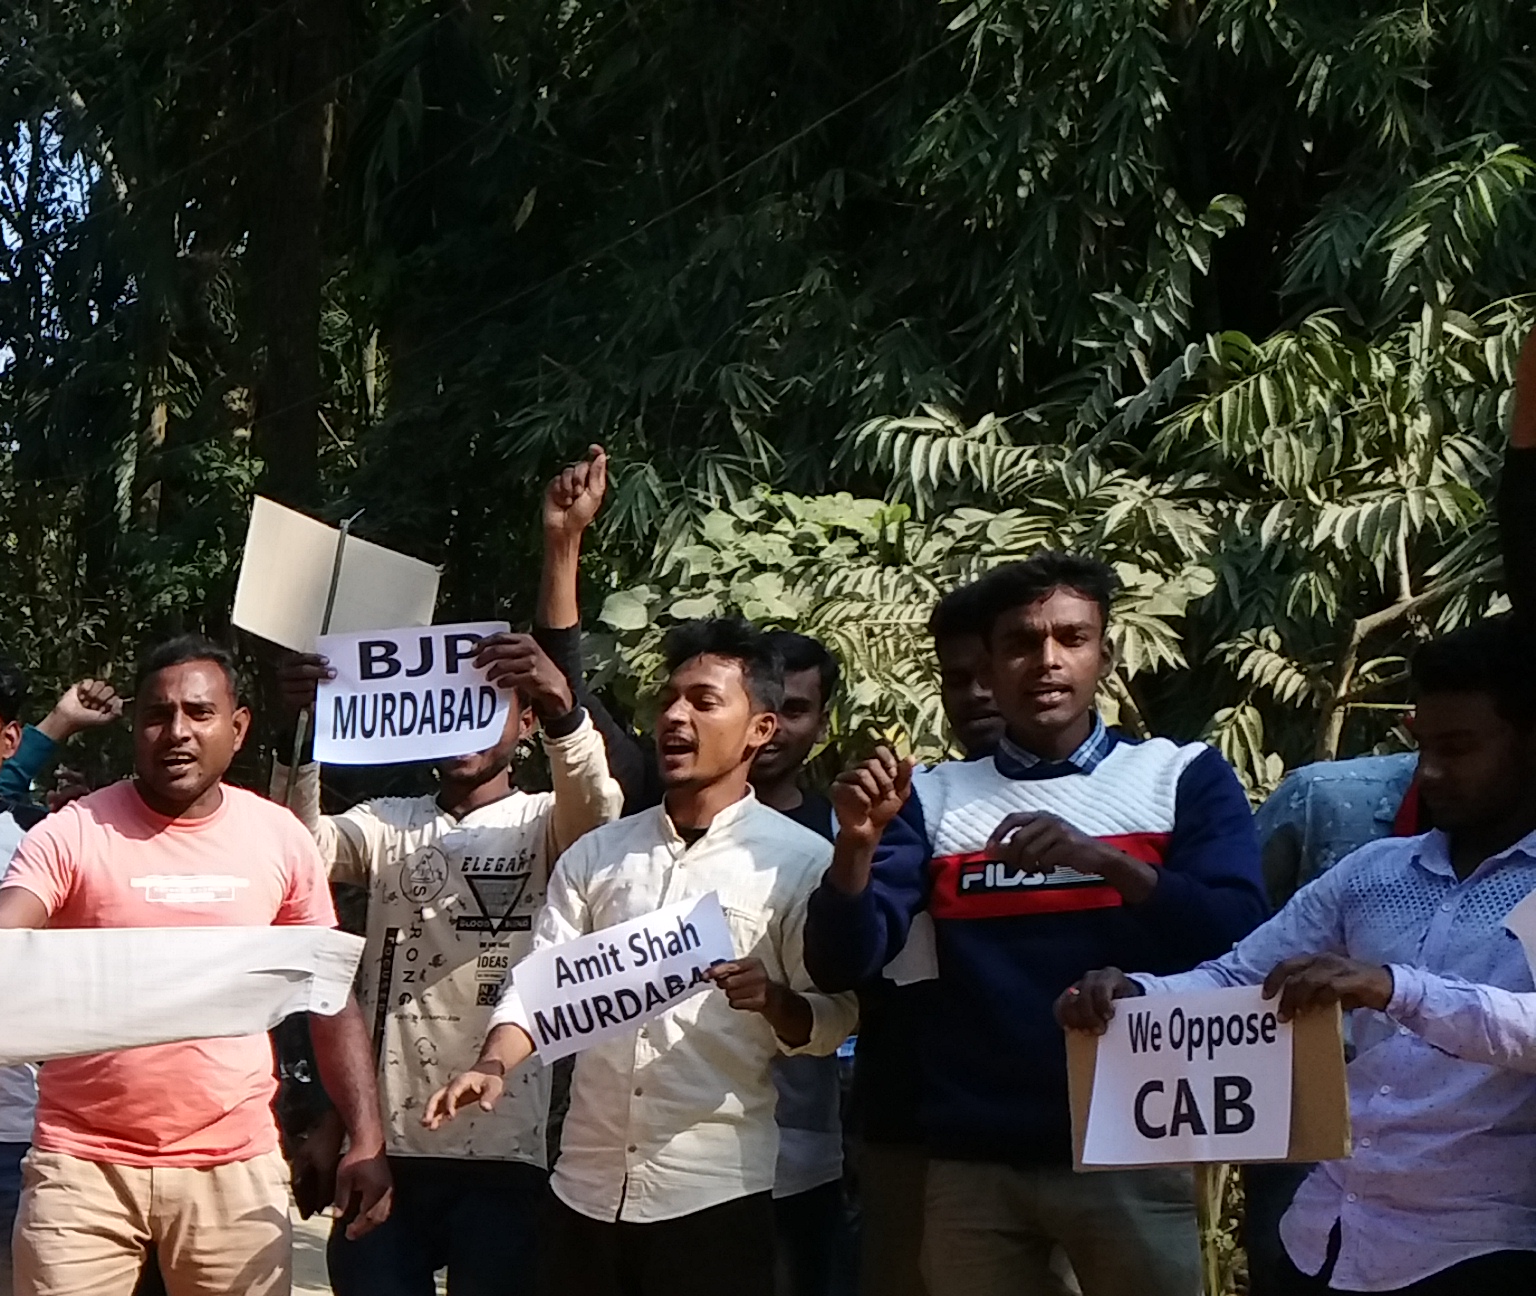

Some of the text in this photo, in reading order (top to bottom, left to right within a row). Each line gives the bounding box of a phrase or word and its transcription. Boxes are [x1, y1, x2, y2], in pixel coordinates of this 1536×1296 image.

[358, 633, 483, 681] BJP
[332, 685, 496, 740] MURDABAD
[477, 955, 508, 969] IDEAS
[555, 915, 702, 989] Amit Shah
[1128, 1007, 1277, 1062] We Oppose
[1134, 1075, 1256, 1140] CAB
